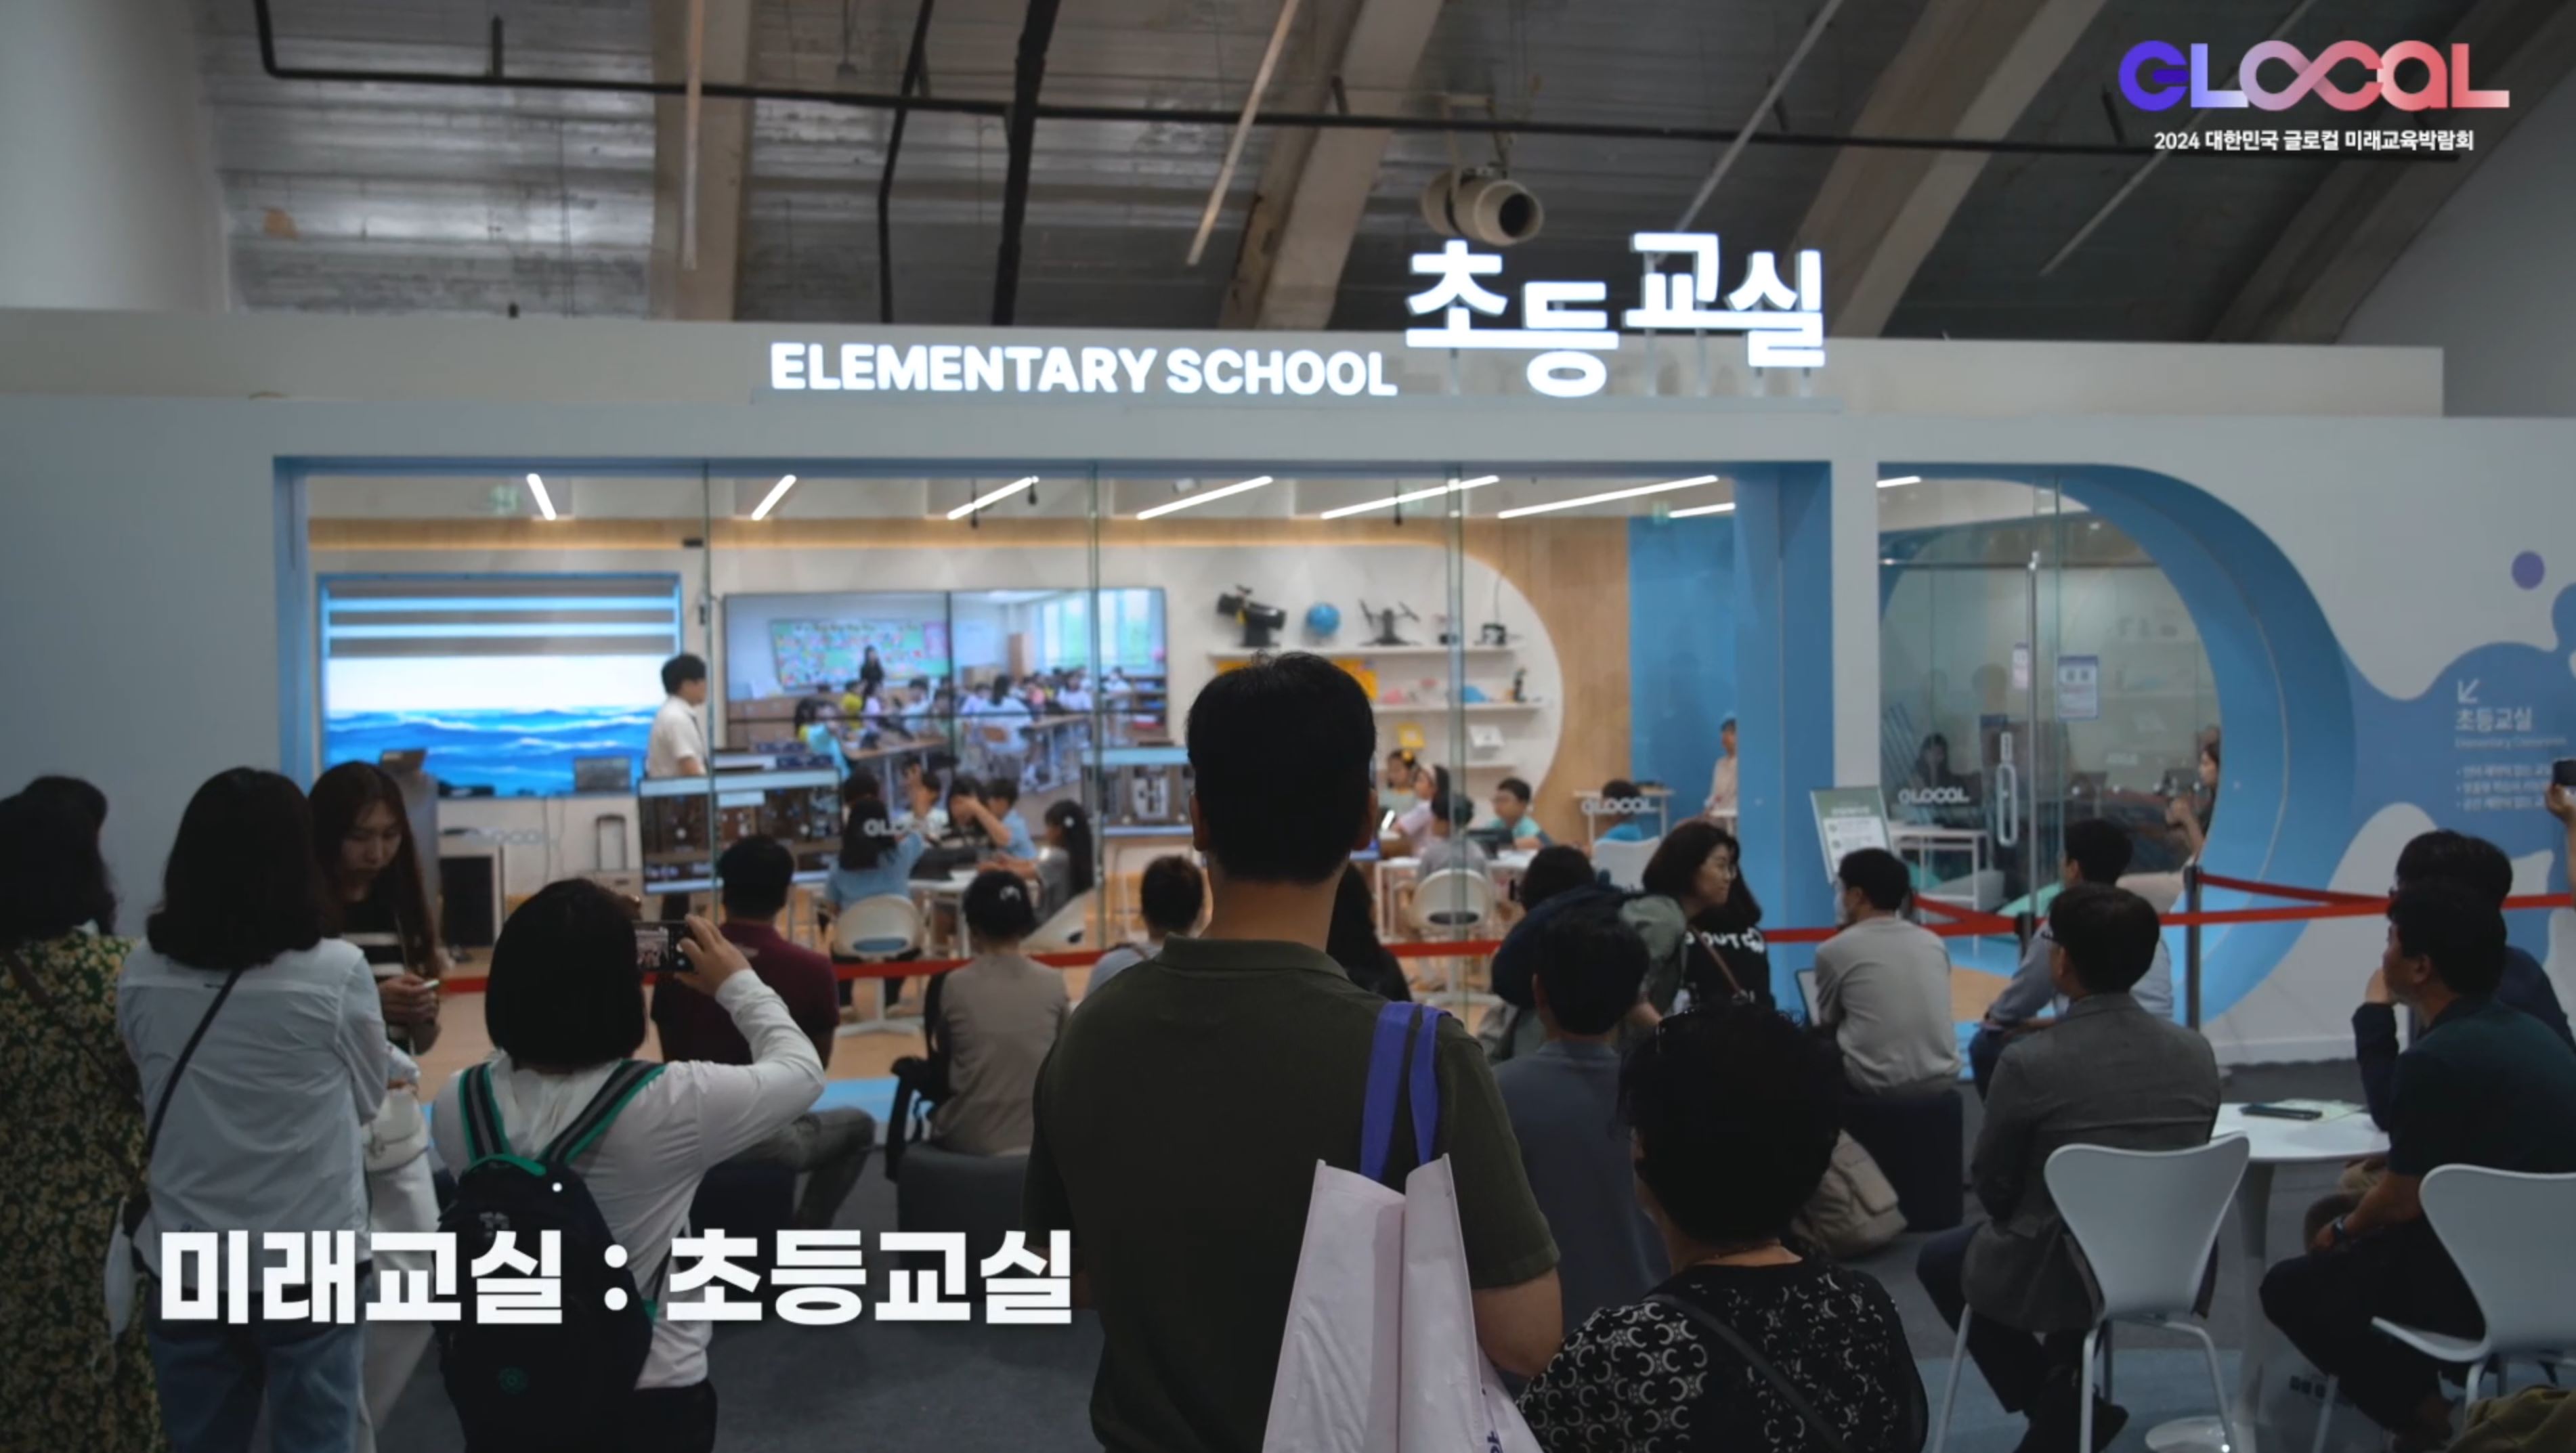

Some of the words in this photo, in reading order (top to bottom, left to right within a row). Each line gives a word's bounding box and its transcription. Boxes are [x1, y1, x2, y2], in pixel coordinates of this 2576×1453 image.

[1406, 233, 1826, 397] 초등교실
[770, 342, 1157, 393] ELEMENTARY
[1166, 349, 1398, 397] SCHOOL
[2455, 707, 2532, 733] 초등교실
